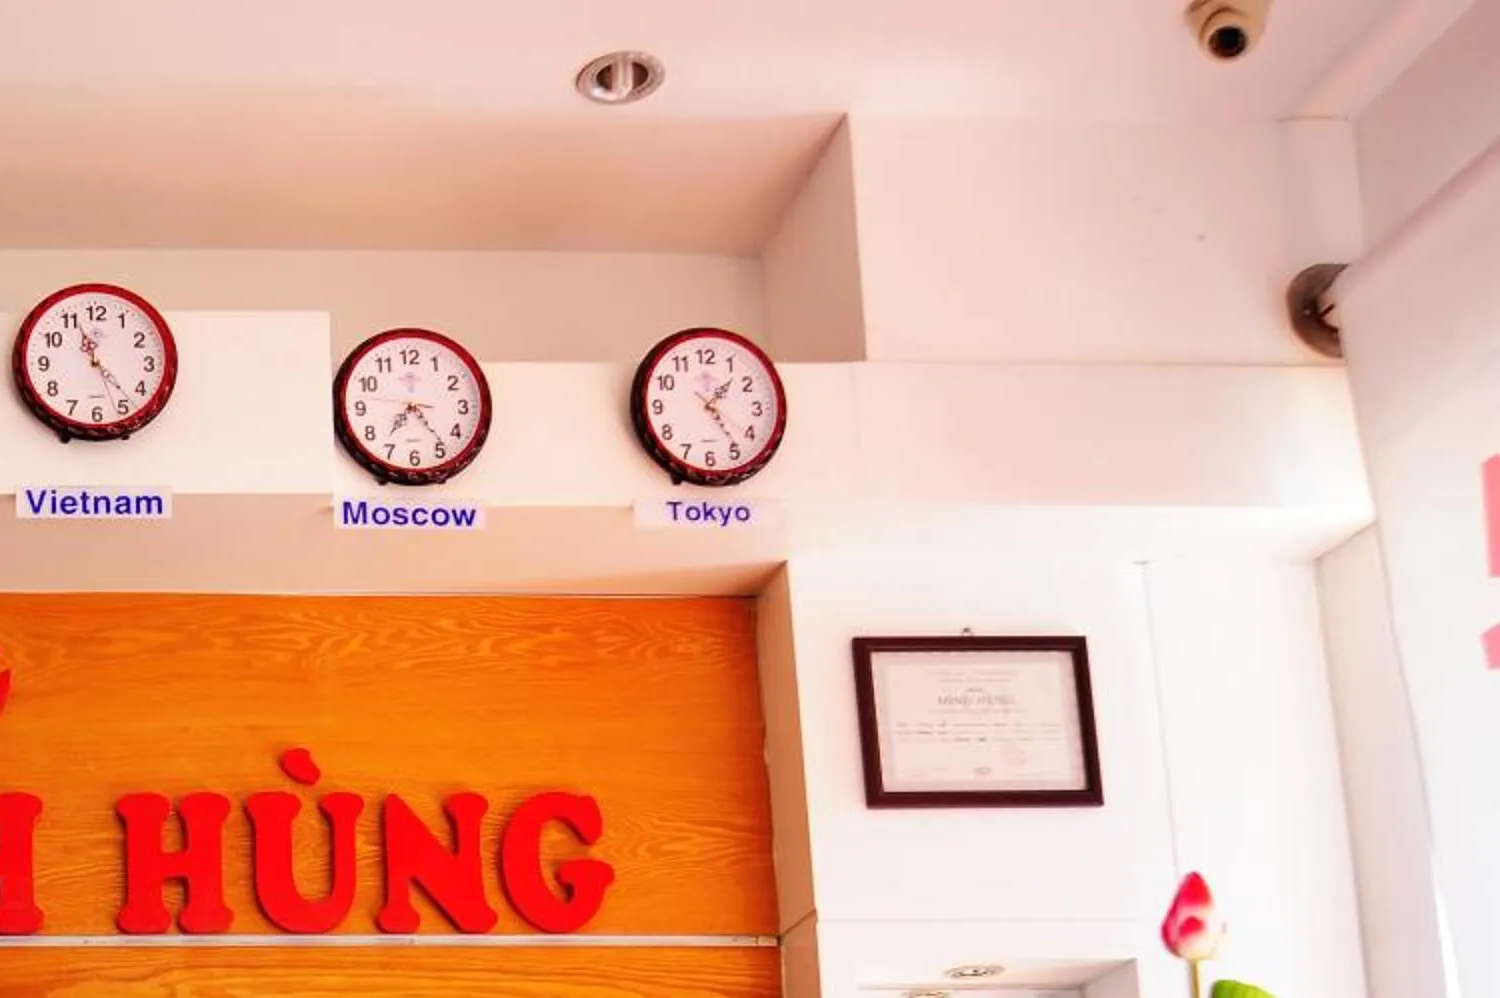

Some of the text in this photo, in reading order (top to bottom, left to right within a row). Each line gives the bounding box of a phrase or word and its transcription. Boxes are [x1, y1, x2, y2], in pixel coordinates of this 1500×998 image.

[61, 313, 77, 328] 11
[86, 306, 107, 321] 12
[117, 313, 126, 329] 1
[44, 331, 62, 348] 10
[133, 332, 145, 349] 2
[38, 356, 49, 372] 9
[143, 356, 155, 372] 3
[375, 357, 391, 373] 11
[400, 349, 420, 365] 12
[430, 357, 439, 372] 1
[672, 356, 689, 372] 11
[696, 349, 716, 365] 12
[725, 357, 733, 372] 1
[47, 381, 58, 396] 8
[135, 380, 146, 396] 4
[359, 376, 377, 392] 10
[447, 375, 459, 391] 2
[656, 375, 674, 391] 10
[741, 376, 753, 393] 2
[66, 400, 78, 416] 7
[92, 406, 103, 422] 6
[117, 399, 129, 415] 5
[355, 401, 366, 416] 9
[457, 400, 469, 415] 3
[652, 399, 663, 415] 9
[751, 401, 763, 417] 3
[364, 425, 376, 441] 8
[450, 423, 461, 439] 4
[662, 424, 673, 440] 8
[745, 426, 755, 441] 4
[384, 444, 395, 460] 7
[409, 450, 421, 466] 6
[434, 443, 446, 459] 5
[680, 444, 692, 460] 7
[704, 451, 716, 467] 6
[729, 443, 741, 461] 5
[26, 490, 163, 516] Vietnam
[342, 501, 476, 527] Moscow
[665, 500, 751, 527] Tokyo
[116, 747, 615, 936] HÙNG
